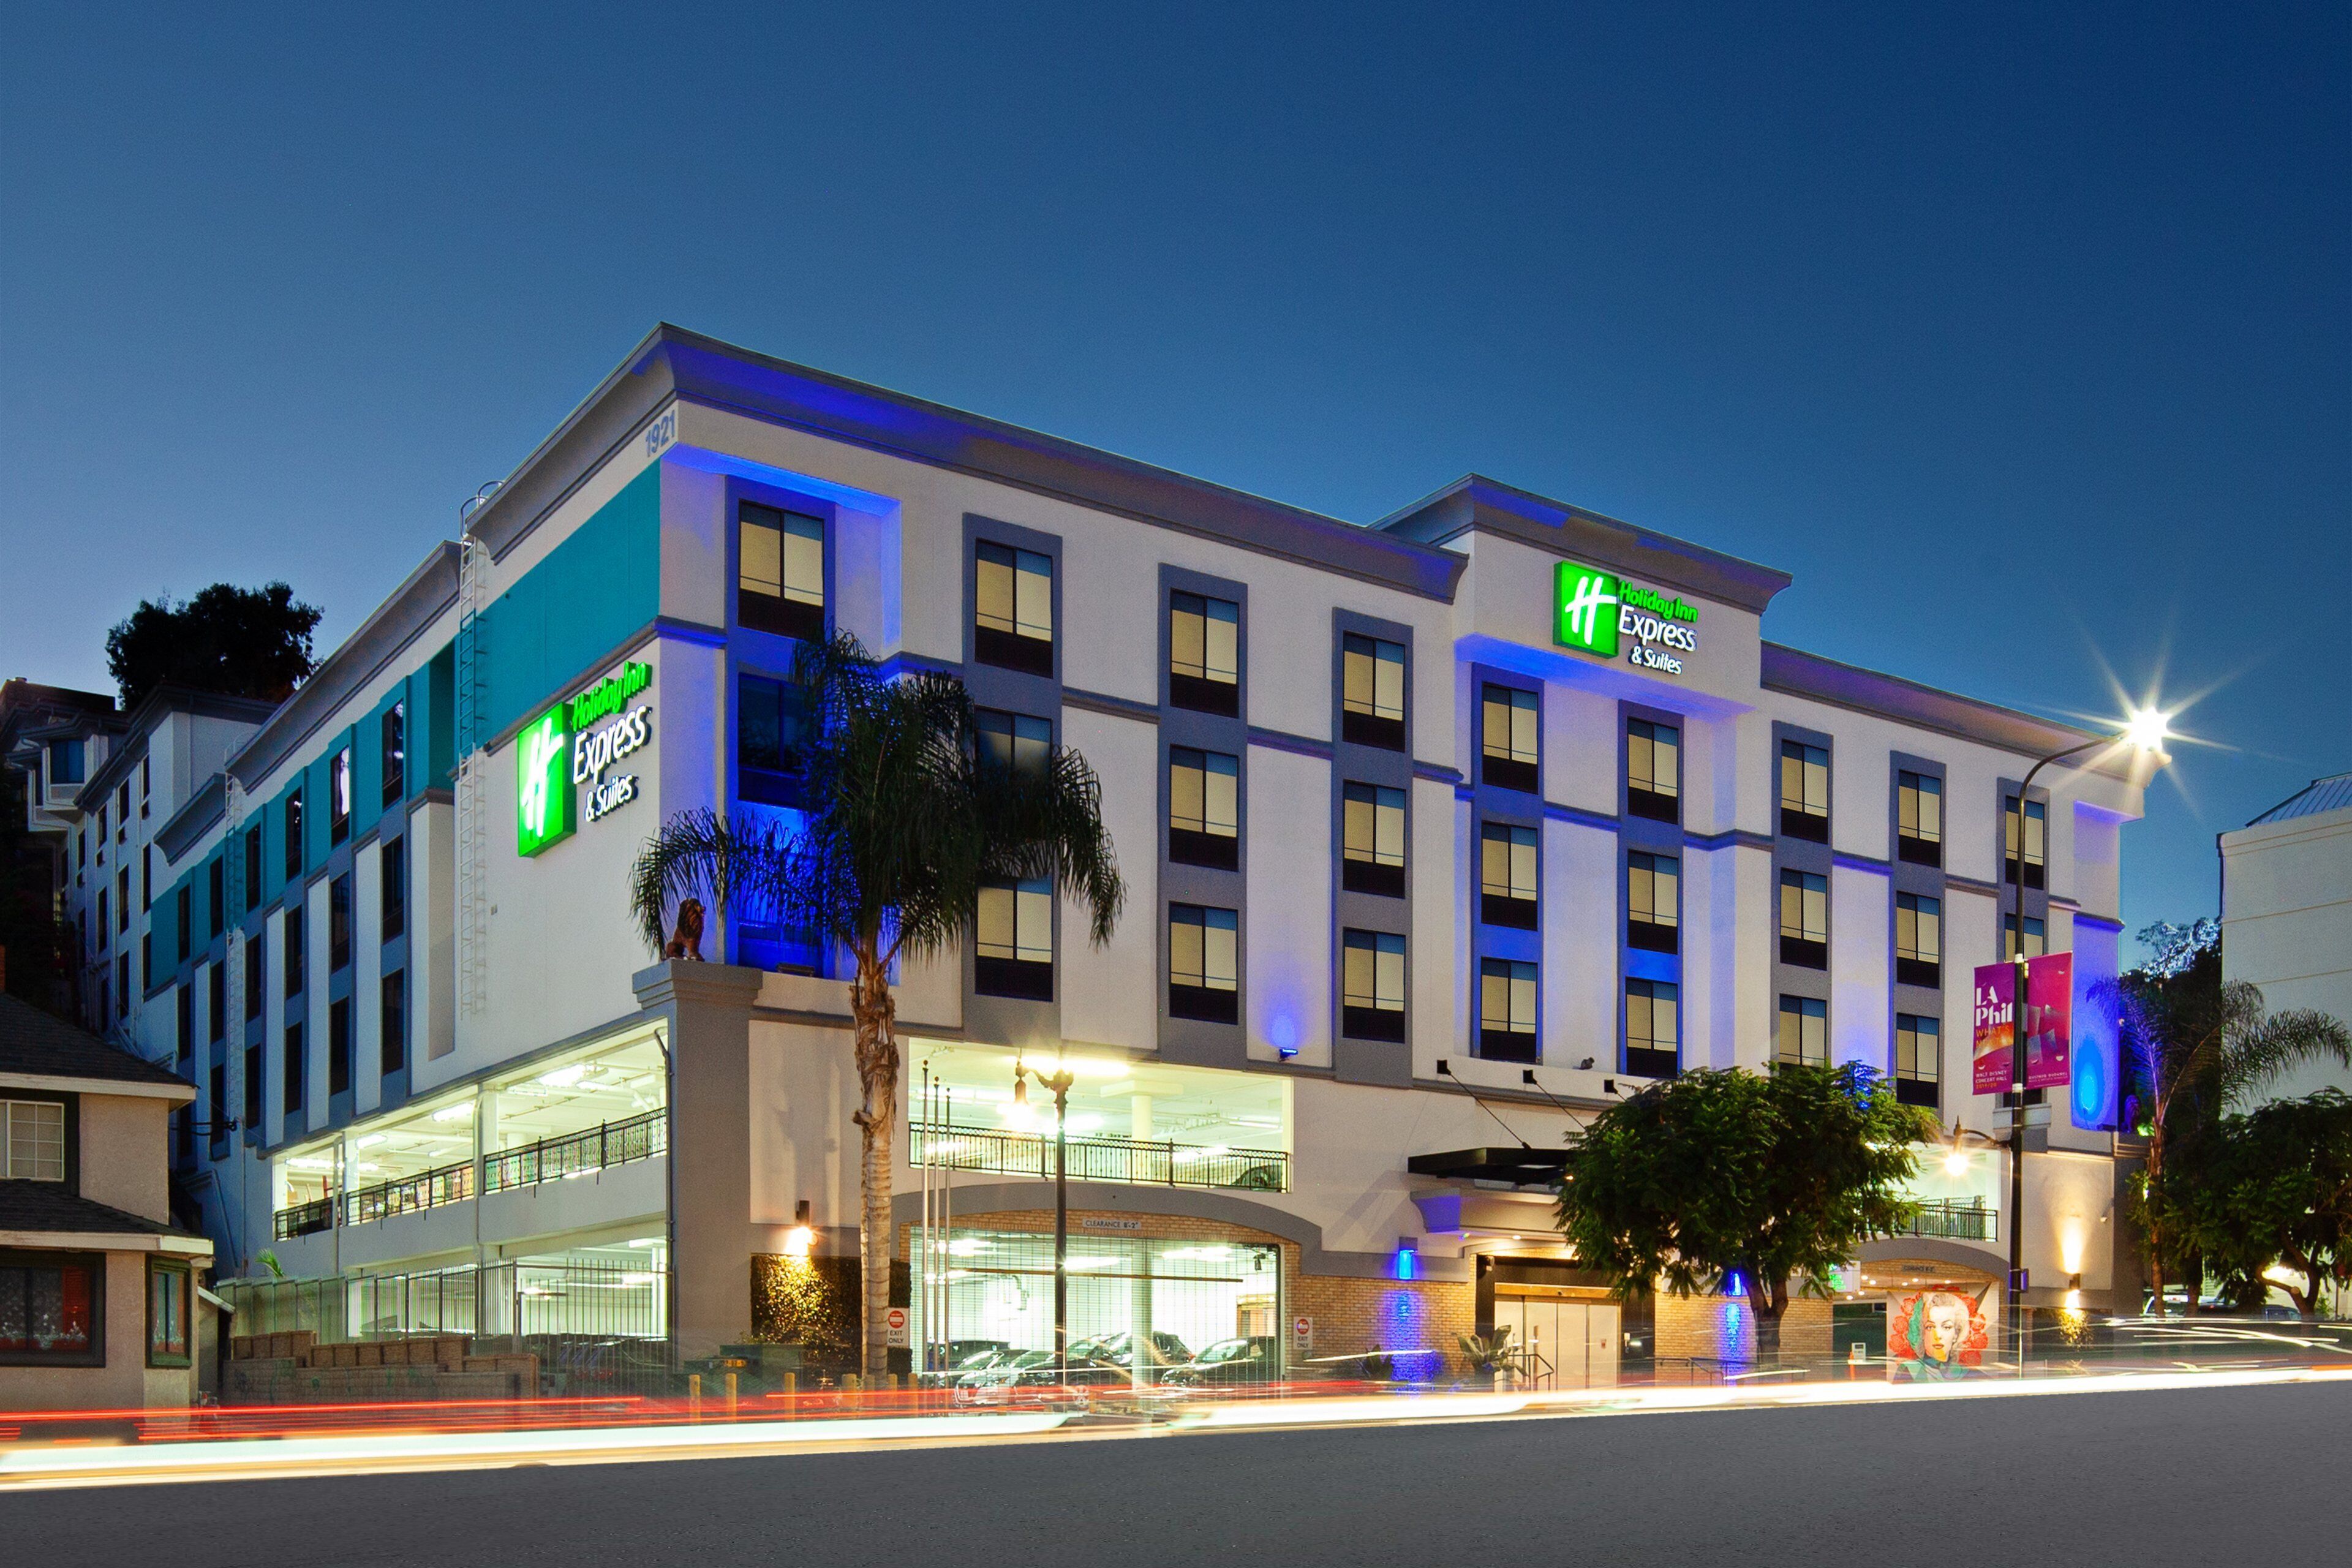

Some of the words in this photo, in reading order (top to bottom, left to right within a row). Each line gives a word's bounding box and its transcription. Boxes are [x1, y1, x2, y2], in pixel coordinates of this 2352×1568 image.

[646, 409, 675, 458] 1921
[1619, 579, 1675, 620] Holiday
[1675, 597, 1698, 623] Inn
[1619, 604, 1697, 652] Express
[1630, 646, 1642, 665] &
[1643, 649, 1682, 675] Suites
[573, 676, 624, 732] Holiday
[624, 661, 648, 698] Inn
[573, 705, 647, 785] Express
[585, 791, 595, 822] &
[595, 774, 633, 816] Suites
[1976, 986, 1999, 1006] LA
[1976, 1002, 2013, 1026] Phil
[1085, 1219, 1121, 1228] CLEARANCE
